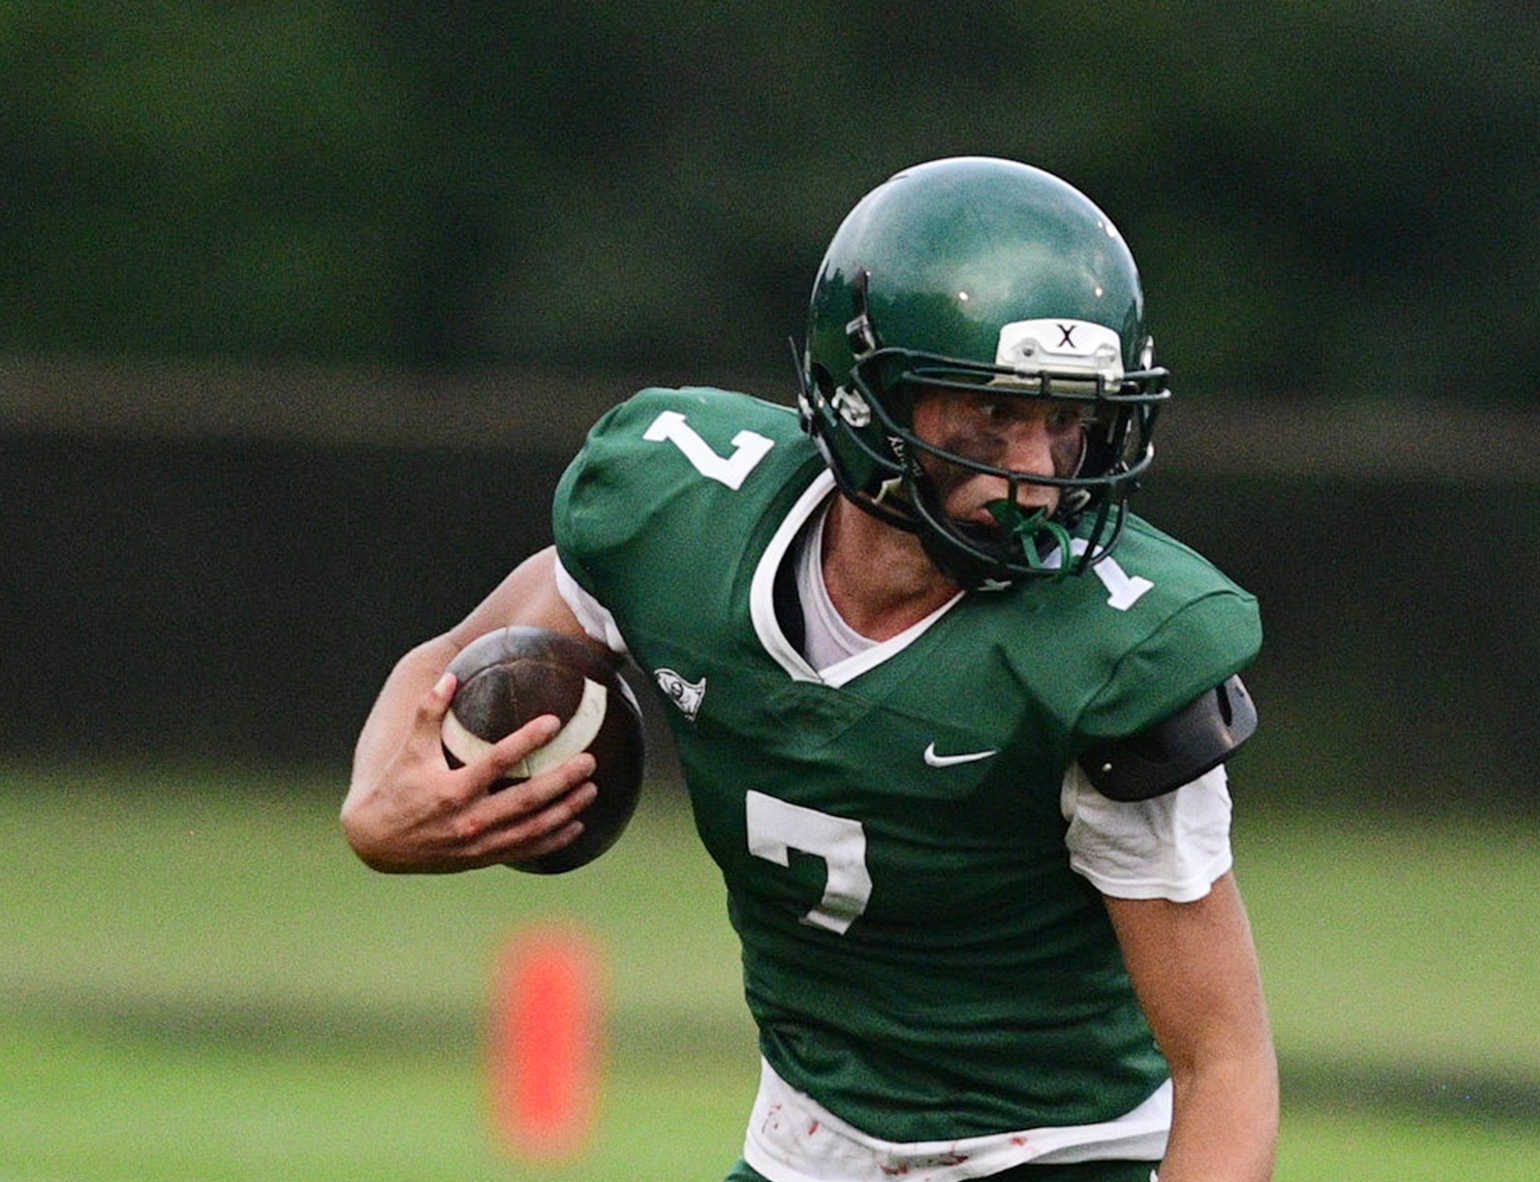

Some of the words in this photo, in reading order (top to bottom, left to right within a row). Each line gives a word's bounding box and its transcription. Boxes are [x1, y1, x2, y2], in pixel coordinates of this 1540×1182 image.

[1056, 323, 1077, 349] X
[642, 408, 776, 491] 7
[745, 788, 873, 936] 7
